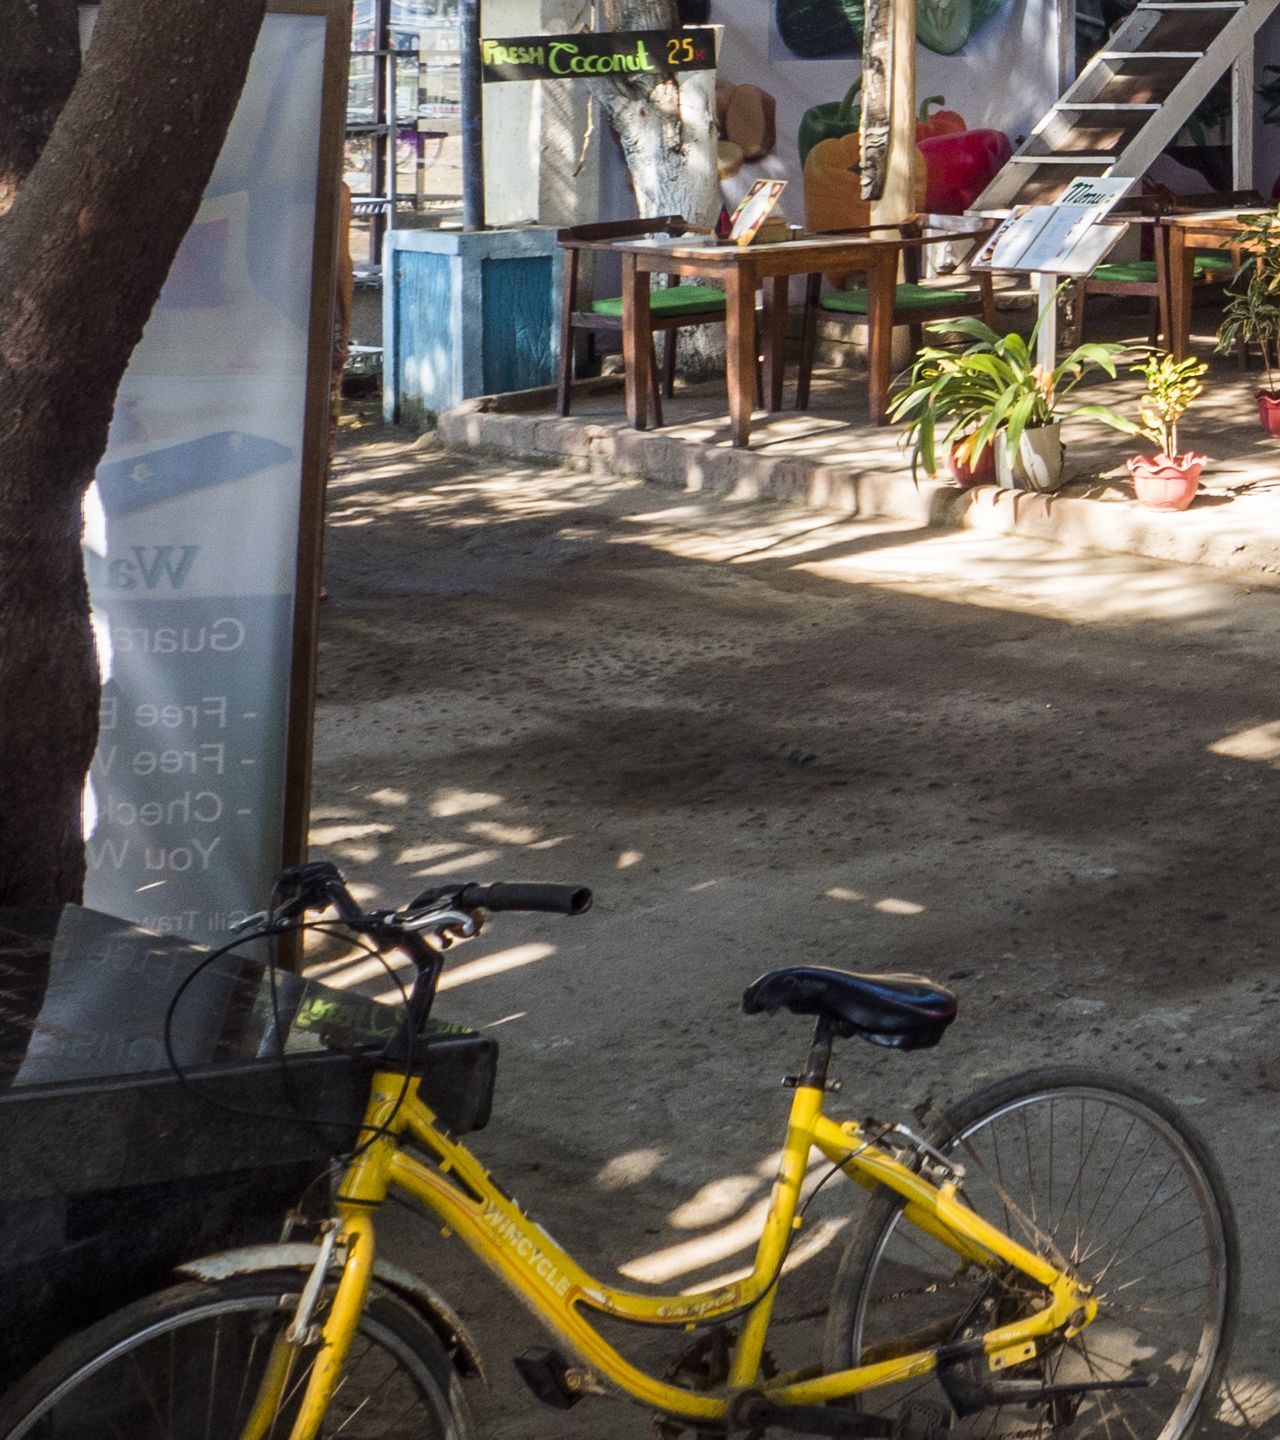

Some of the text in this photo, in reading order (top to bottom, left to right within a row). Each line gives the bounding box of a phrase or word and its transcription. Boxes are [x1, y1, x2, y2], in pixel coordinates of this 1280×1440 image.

[483, 40, 654, 75] FRESH Coconut
[667, 38, 694, 65] 25
[1062, 182, 1105, 203] Menu
[484, 1201, 571, 1298] WINCYCLE
